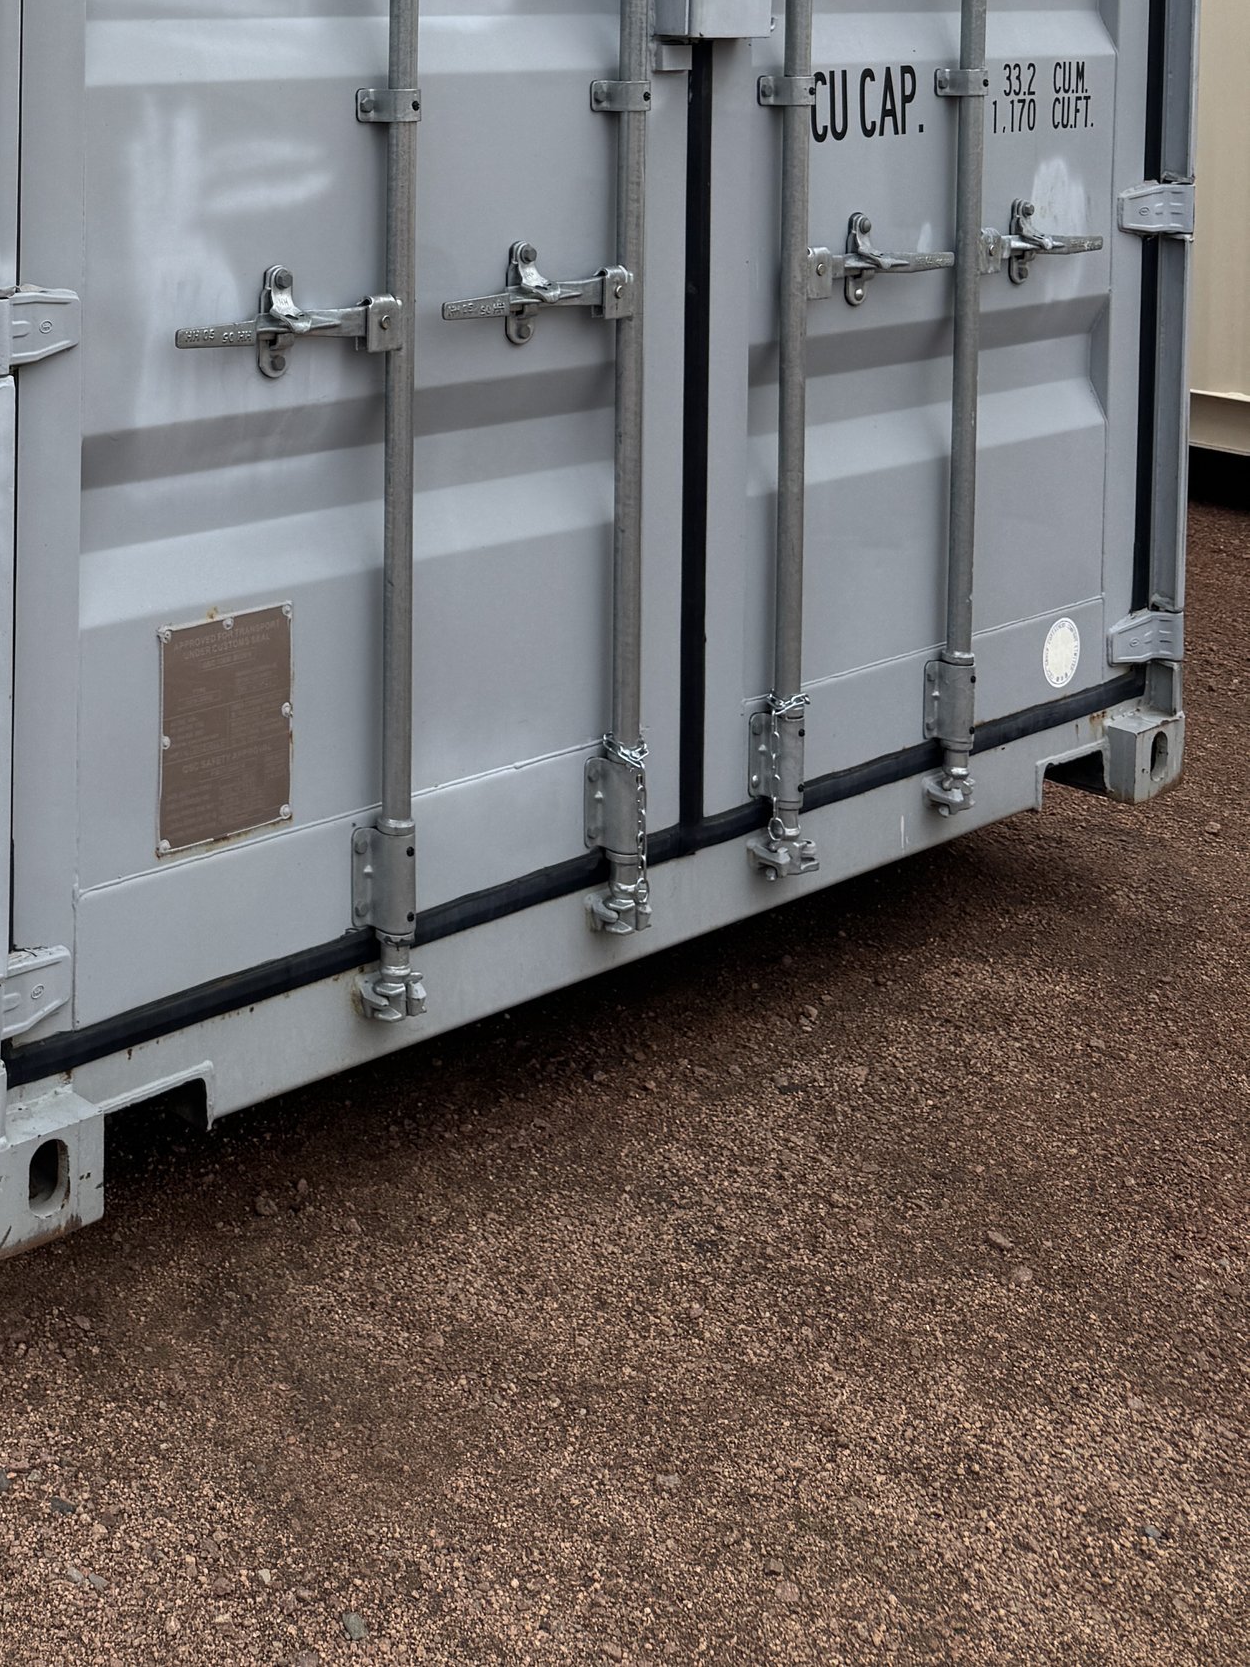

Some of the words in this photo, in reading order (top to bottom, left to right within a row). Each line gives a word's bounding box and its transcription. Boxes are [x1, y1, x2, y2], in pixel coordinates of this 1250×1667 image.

[810, 70, 848, 143] CU
[860, 65, 924, 138] CAP.
[1003, 63, 1036, 96] 33.2
